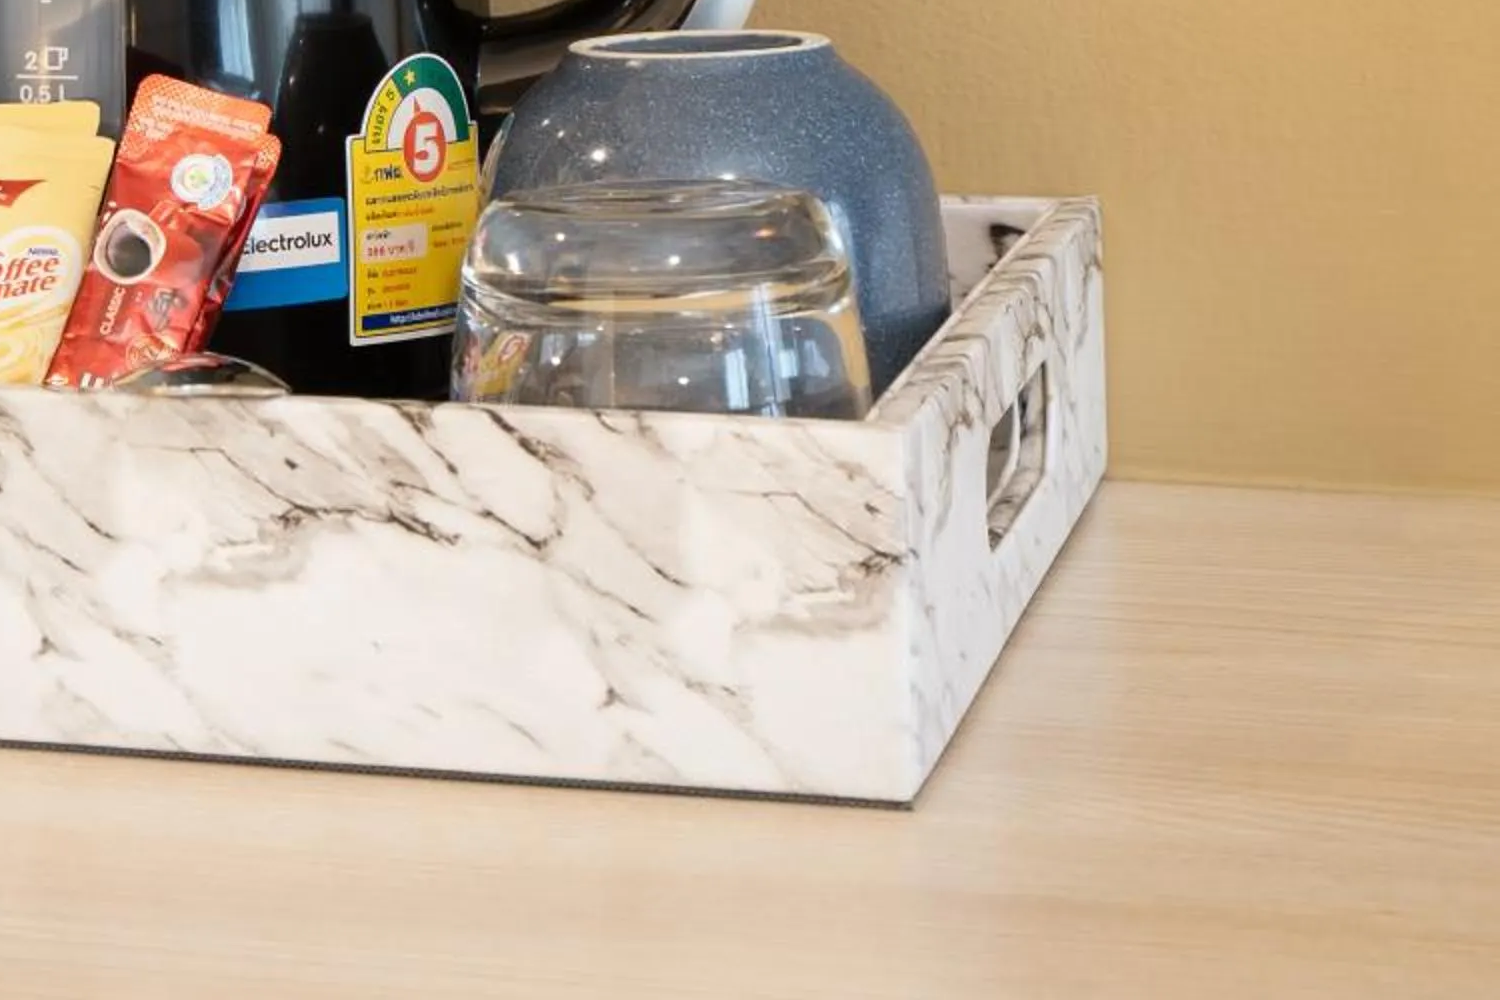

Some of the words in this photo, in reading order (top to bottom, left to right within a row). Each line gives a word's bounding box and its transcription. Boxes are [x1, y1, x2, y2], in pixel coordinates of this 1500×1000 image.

[24, 51, 38, 70] 2
[20, 85, 52, 104] 0.5
[412, 122, 440, 176] 5
[99, 286, 126, 335] CLASSIC
